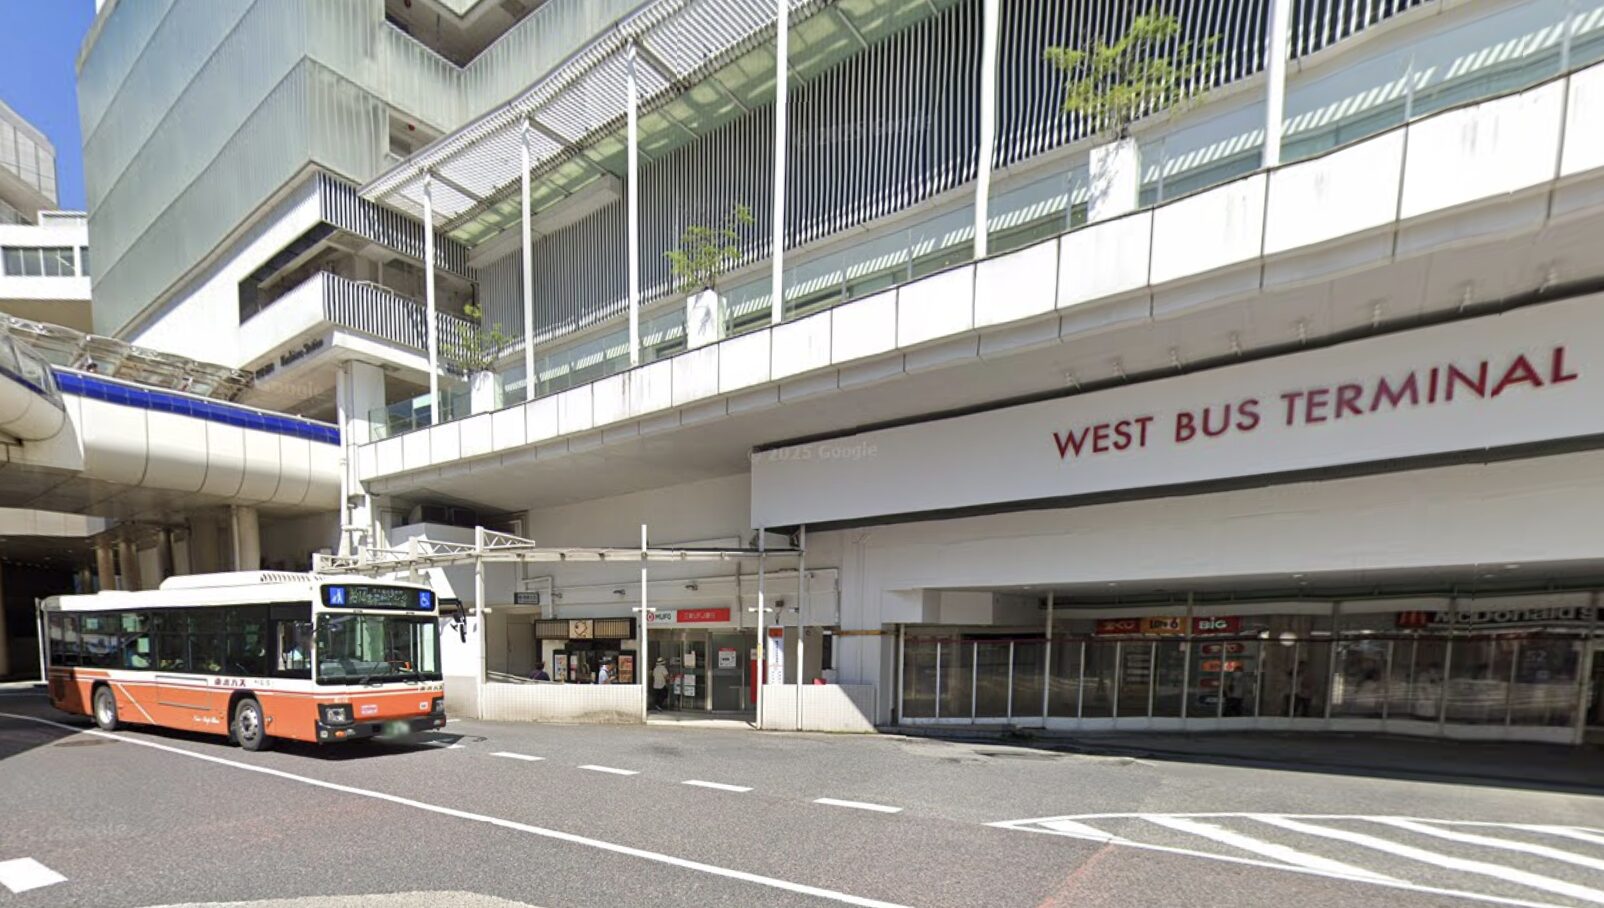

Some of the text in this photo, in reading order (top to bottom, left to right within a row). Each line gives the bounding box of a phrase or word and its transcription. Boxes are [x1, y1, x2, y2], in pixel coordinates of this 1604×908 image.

[1053, 347, 1579, 459] WEST BUS TERMINAL
